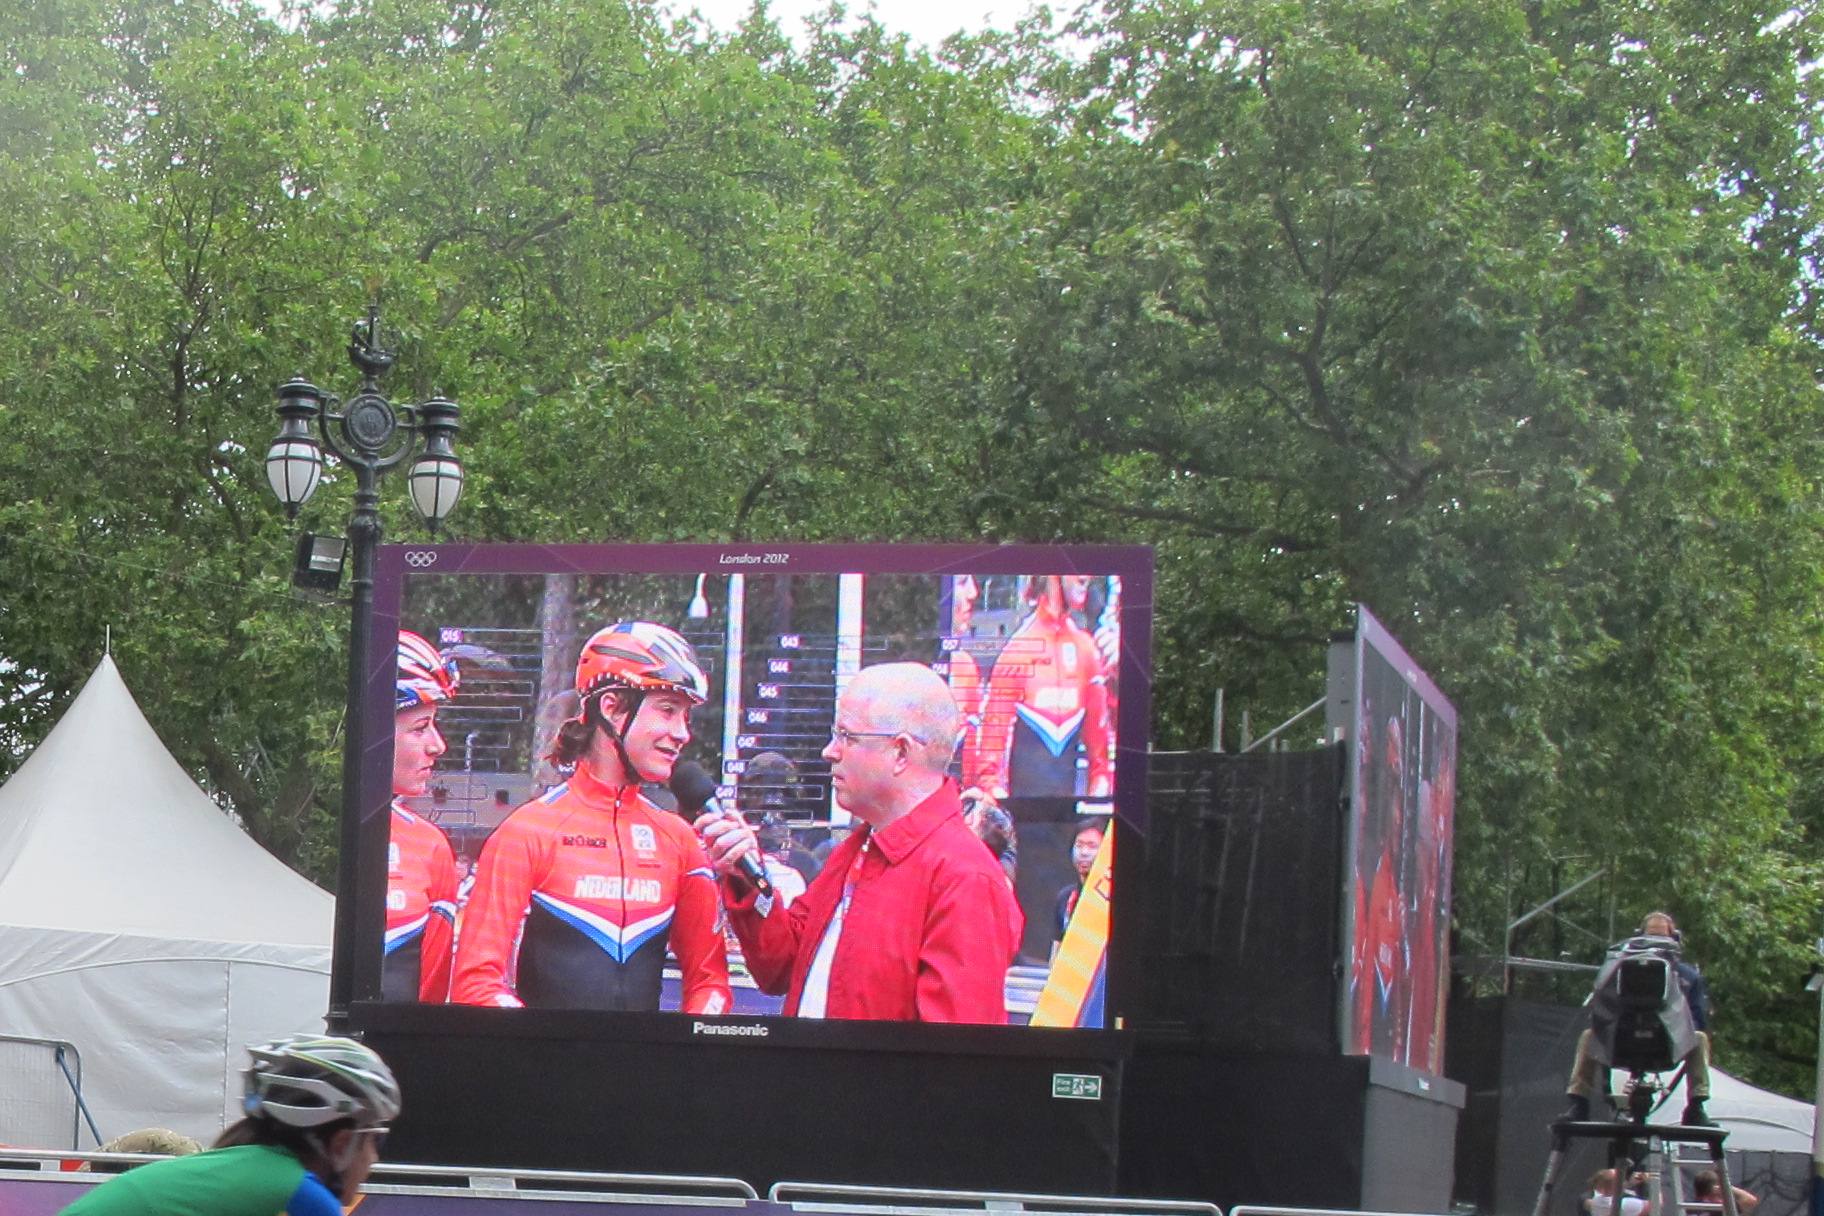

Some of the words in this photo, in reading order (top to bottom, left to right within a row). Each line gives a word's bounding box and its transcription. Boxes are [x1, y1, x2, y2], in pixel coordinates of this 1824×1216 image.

[719, 553, 761, 564] London
[762, 553, 789, 564] 2012
[693, 1021, 769, 1036] Panasonic
